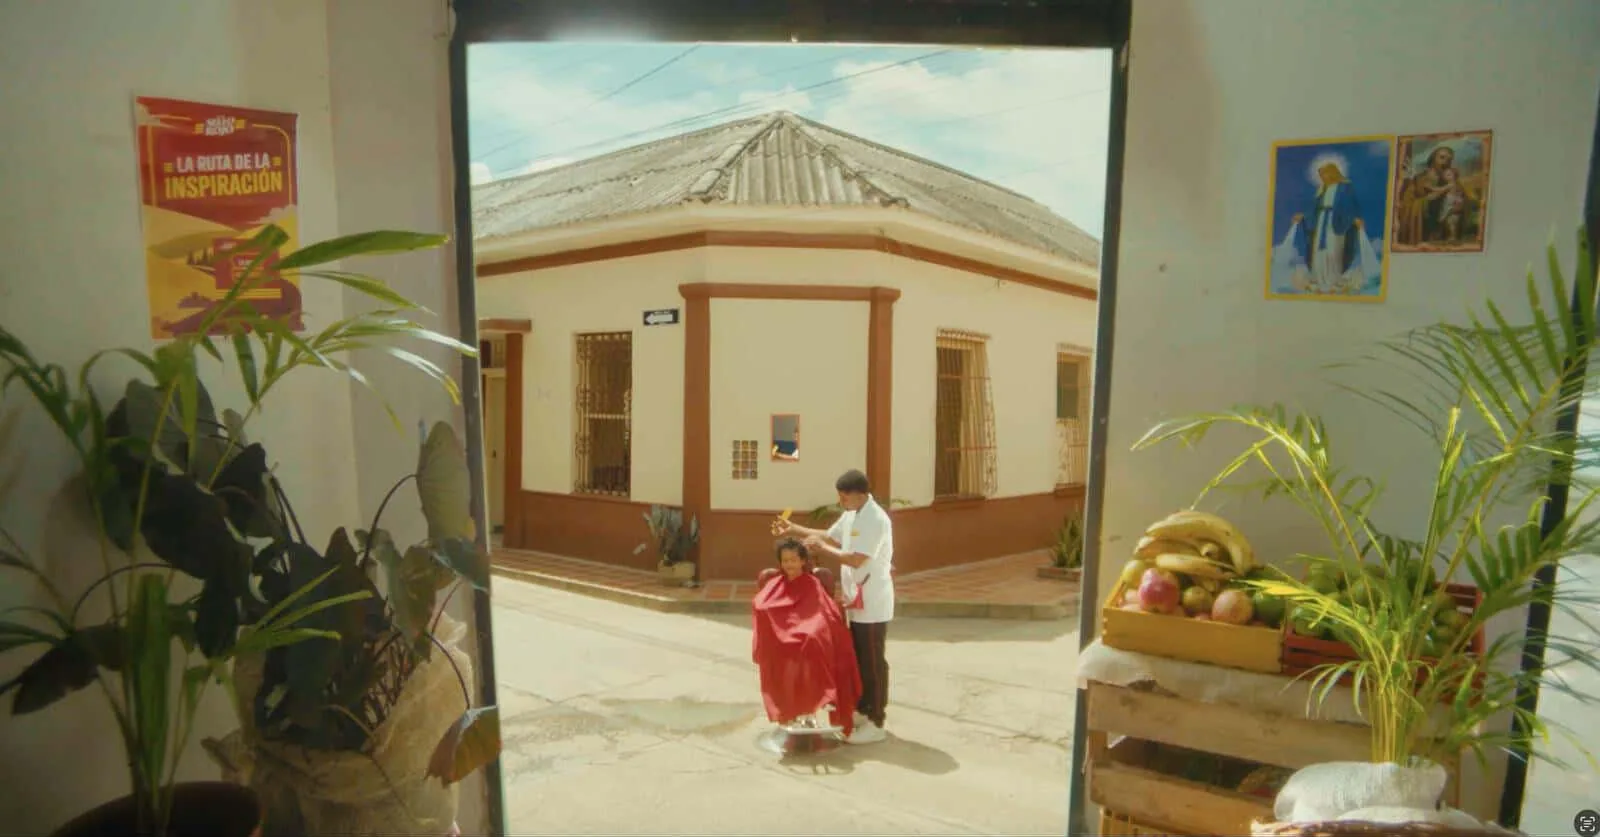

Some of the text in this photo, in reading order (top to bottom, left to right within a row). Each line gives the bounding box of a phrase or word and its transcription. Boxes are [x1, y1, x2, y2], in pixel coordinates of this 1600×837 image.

[177, 152, 271, 173] LA RUTA DE LA
[165, 168, 282, 199] INSPIRACIÓN
